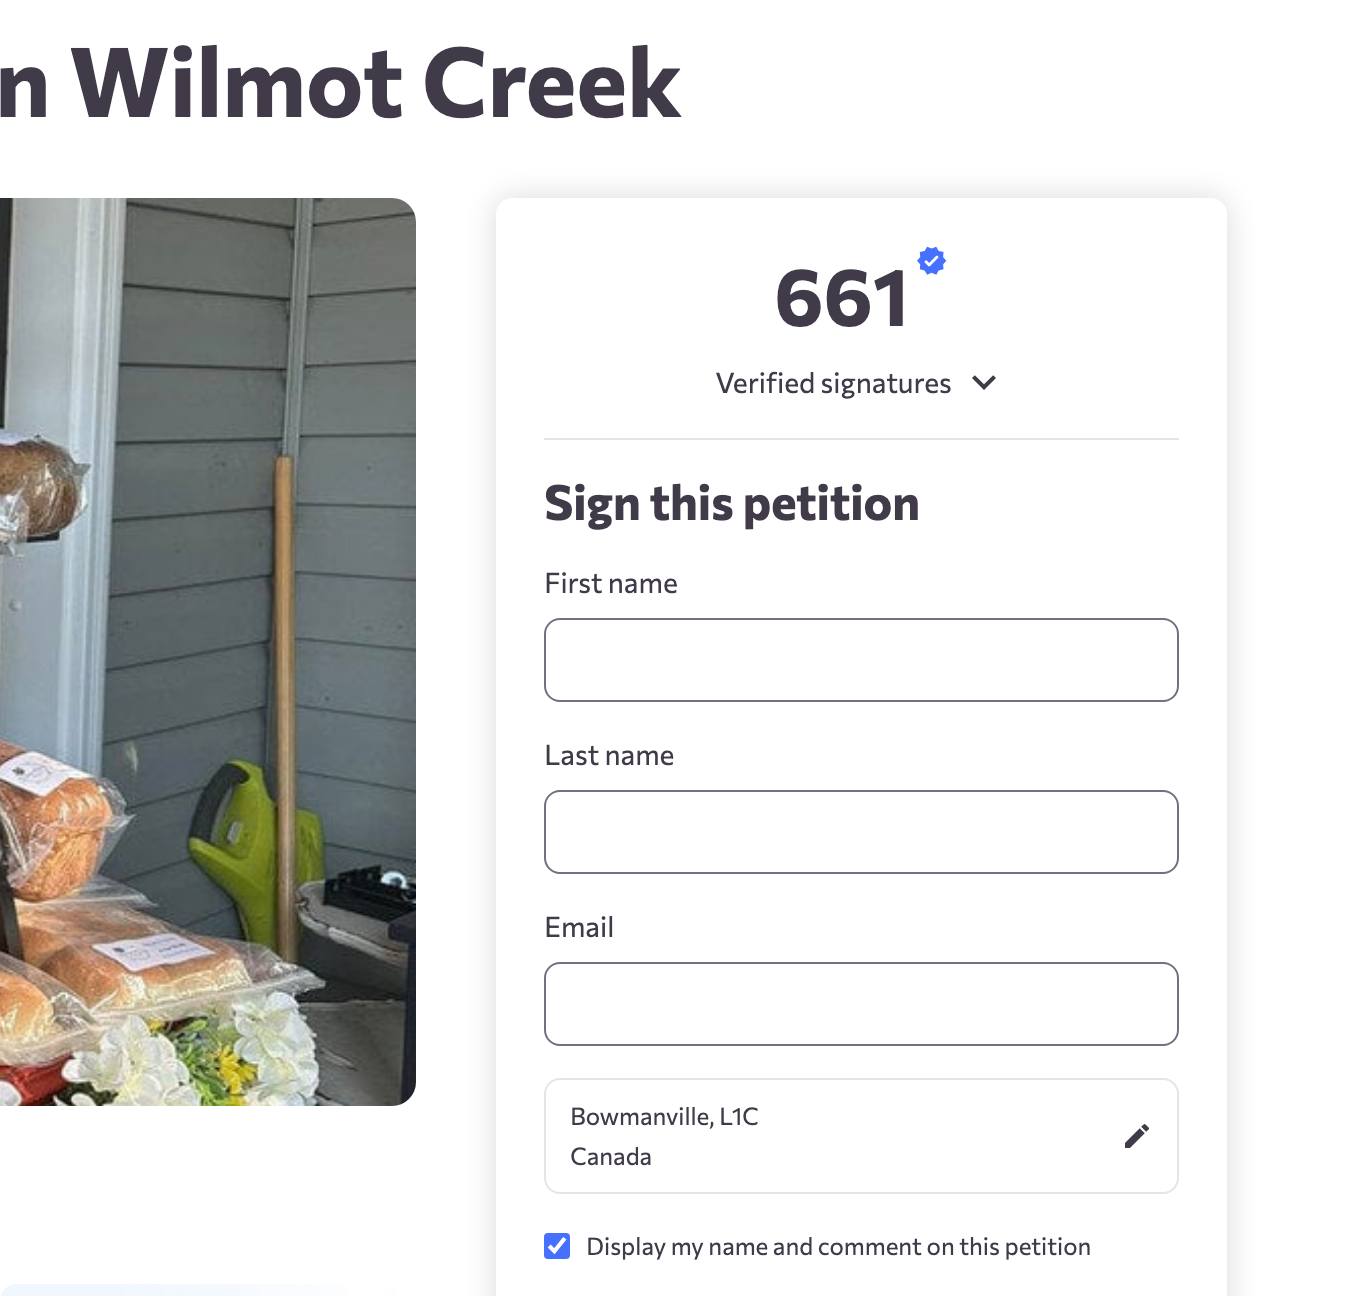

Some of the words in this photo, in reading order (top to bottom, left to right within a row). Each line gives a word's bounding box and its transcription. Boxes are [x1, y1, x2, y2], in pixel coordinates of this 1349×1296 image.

[70, 44, 403, 119] Wilmot
[424, 44, 682, 119] Creek
[776, 268, 904, 328] 661
[715, 371, 814, 394] Verified
[821, 371, 952, 400] signatures
[545, 483, 640, 531] Sign
[649, 483, 733, 522] this
[744, 483, 919, 530] petition
[546, 571, 603, 594] First
[609, 577, 678, 594] name
[546, 744, 600, 766] Last
[606, 749, 674, 766] name
[546, 915, 613, 938] Email
[571, 1106, 714, 1130] Bowmanville,
[720, 1106, 759, 1126] L1C
[570, 1146, 651, 1166] Canada
[587, 1236, 667, 1261] Display
[672, 1242, 704, 1261] my
[709, 1242, 768, 1256] name
[773, 1236, 813, 1256] and
[818, 1238, 922, 1256] comment
[927, 1242, 954, 1256] on
[959, 1236, 1000, 1256] this
[1005, 1236, 1091, 1261] petition
